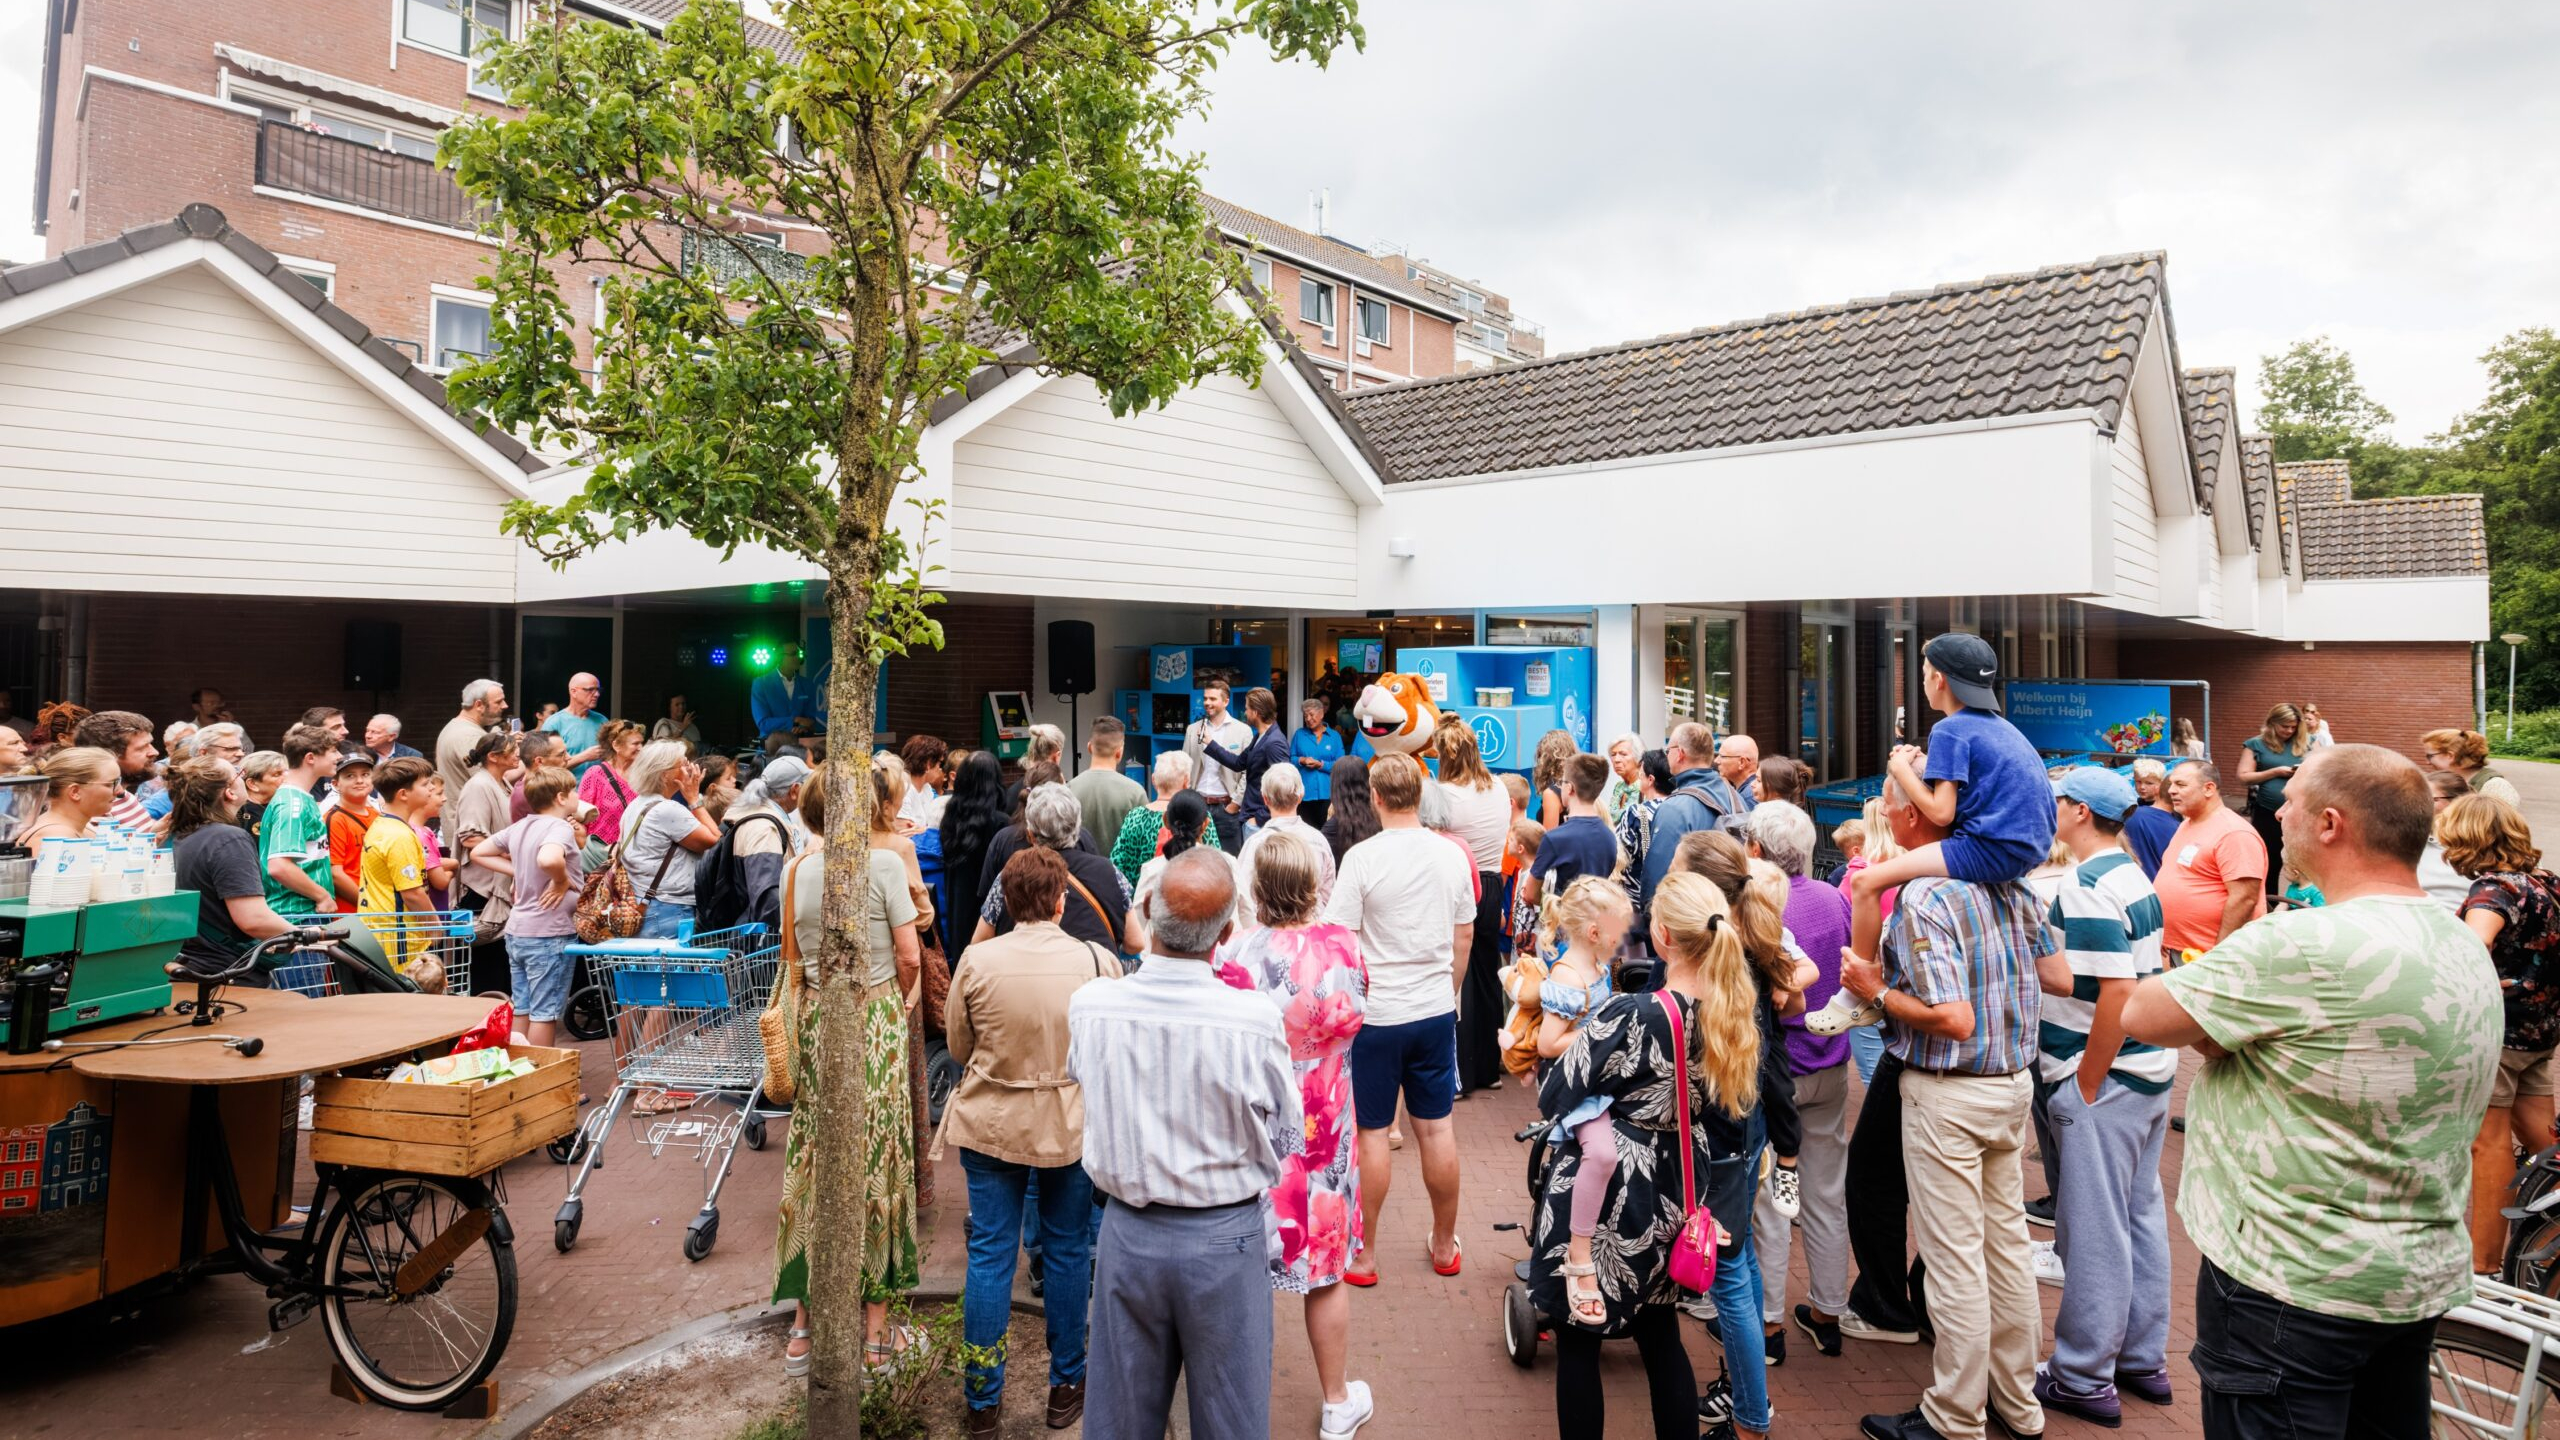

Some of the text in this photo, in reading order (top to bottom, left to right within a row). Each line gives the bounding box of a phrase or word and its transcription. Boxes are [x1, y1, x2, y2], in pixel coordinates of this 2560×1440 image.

[2013, 692, 2086, 705] Welkom bij
[2013, 705, 2093, 718] Albert Heijn
